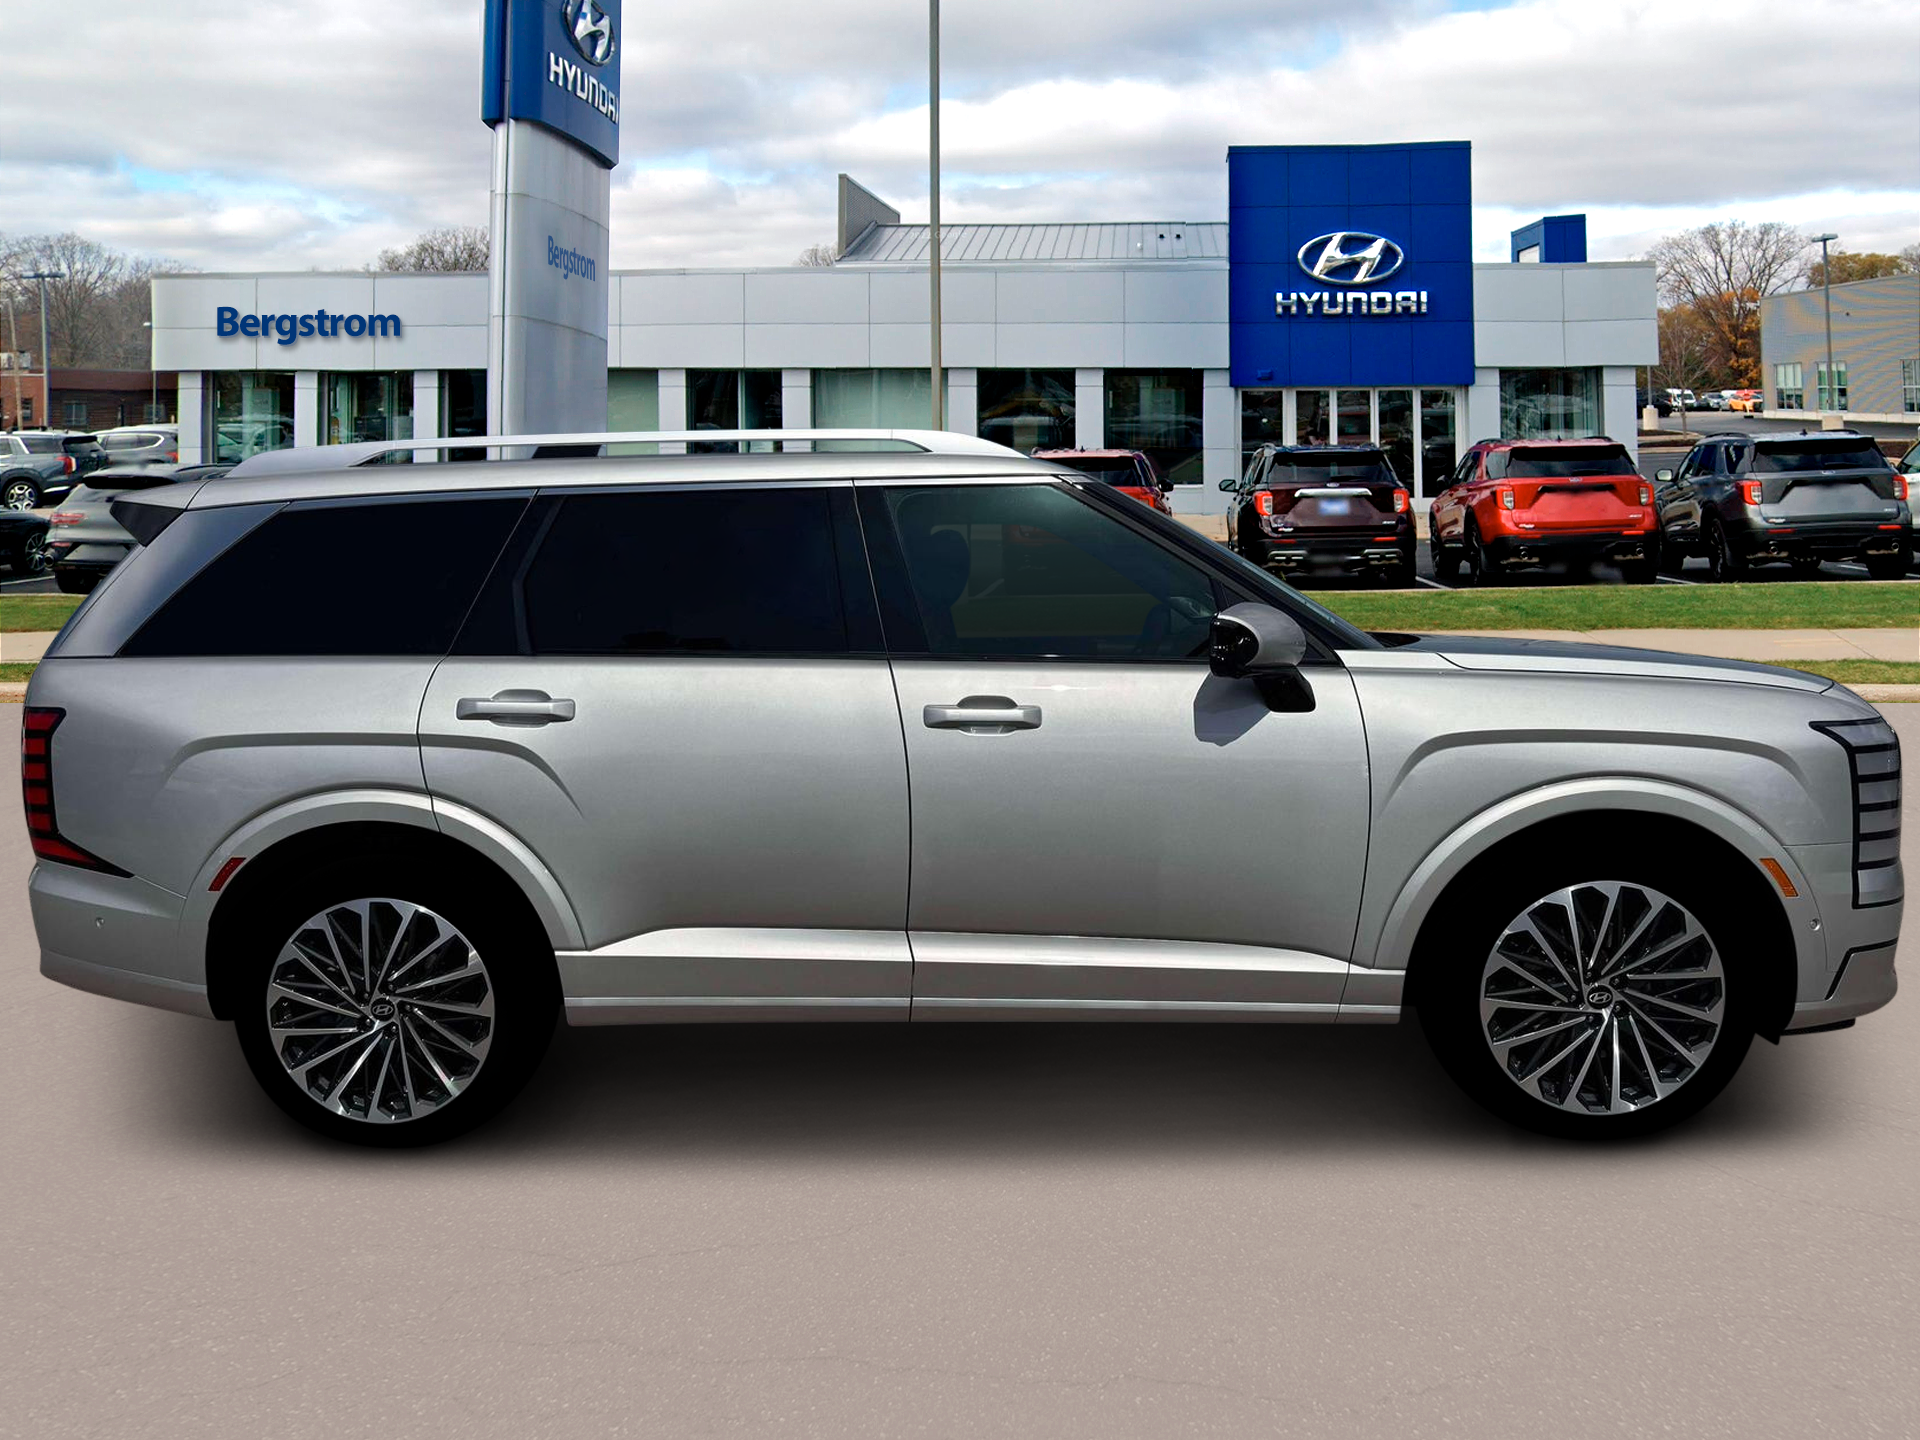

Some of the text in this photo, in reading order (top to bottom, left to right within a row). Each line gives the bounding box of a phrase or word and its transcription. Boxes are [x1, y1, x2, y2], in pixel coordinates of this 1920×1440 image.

[548, 52, 619, 124] HYUNDAI
[547, 235, 596, 281] Bergstrom
[1275, 291, 1428, 315] HYUNDAI
[217, 306, 401, 346] Bergstrom
